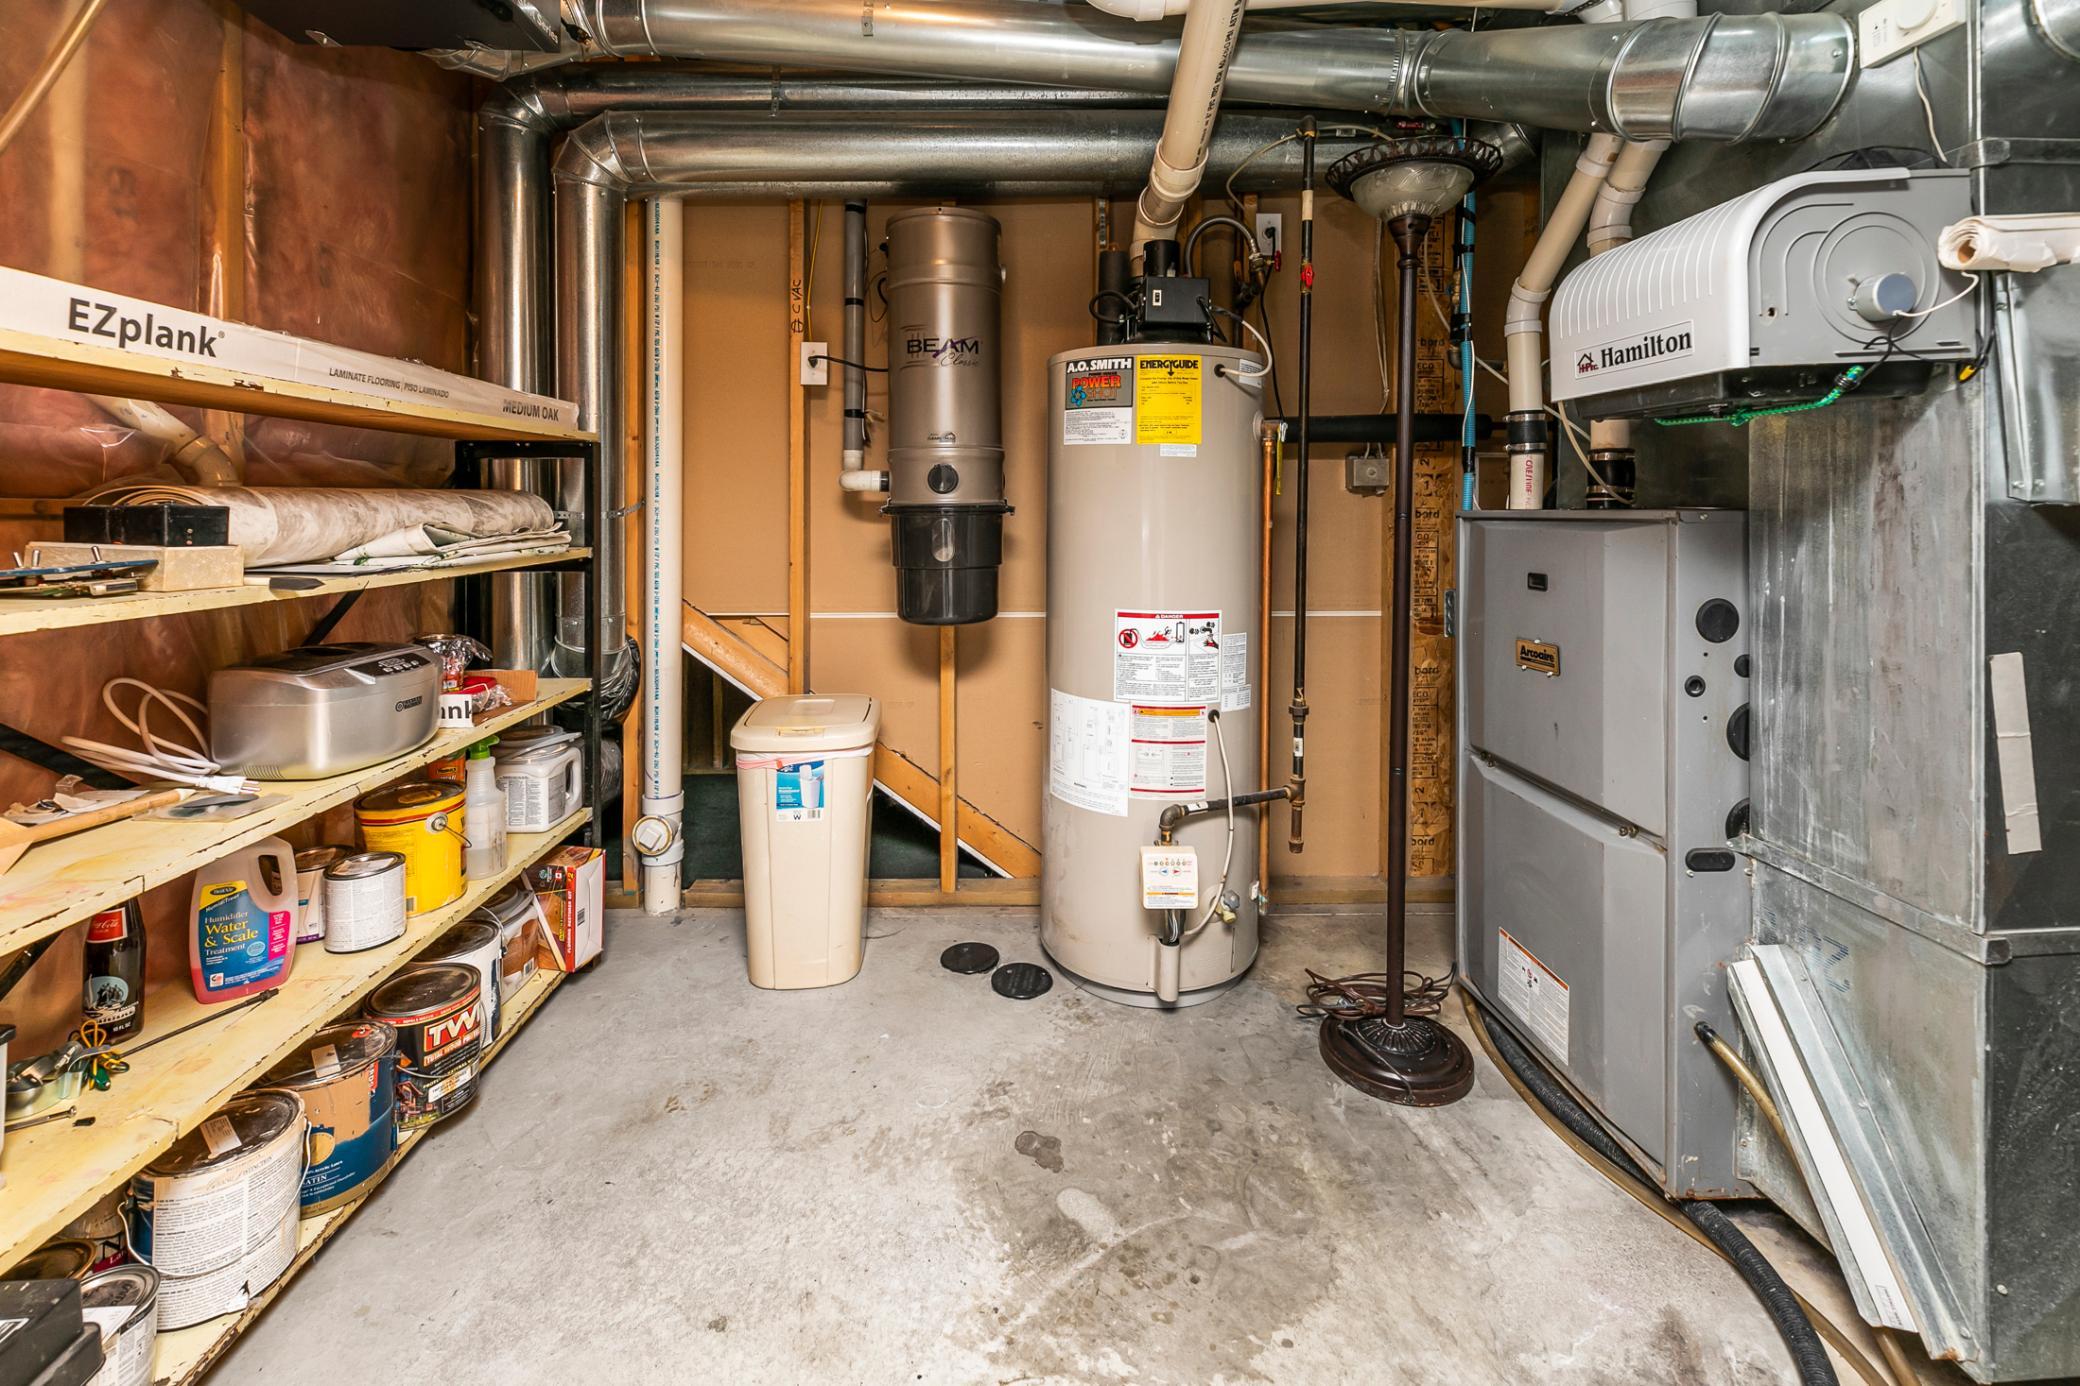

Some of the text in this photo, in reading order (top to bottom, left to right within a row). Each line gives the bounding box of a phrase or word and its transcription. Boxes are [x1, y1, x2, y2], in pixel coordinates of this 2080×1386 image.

[791, 279, 803, 301] VAC
[69, 298, 217, 358] EZplank
[906, 338, 979, 355] BEAM
[1600, 332, 1692, 369] Hamilton
[1067, 358, 1132, 373] A.O. SMITH
[1139, 360, 1199, 371] ENERGYGUIDE
[329, 367, 401, 390] LAMINATE FLOORING
[1072, 375, 1121, 389] POWER
[502, 399, 559, 421] MEDIUM OAK
[1520, 644, 1555, 662] Arcoaire
[205, 911, 249, 924] Humidifier
[205, 919, 249, 936] Water
[205, 929, 259, 948] & Scale
[206, 943, 246, 956] Treatment
